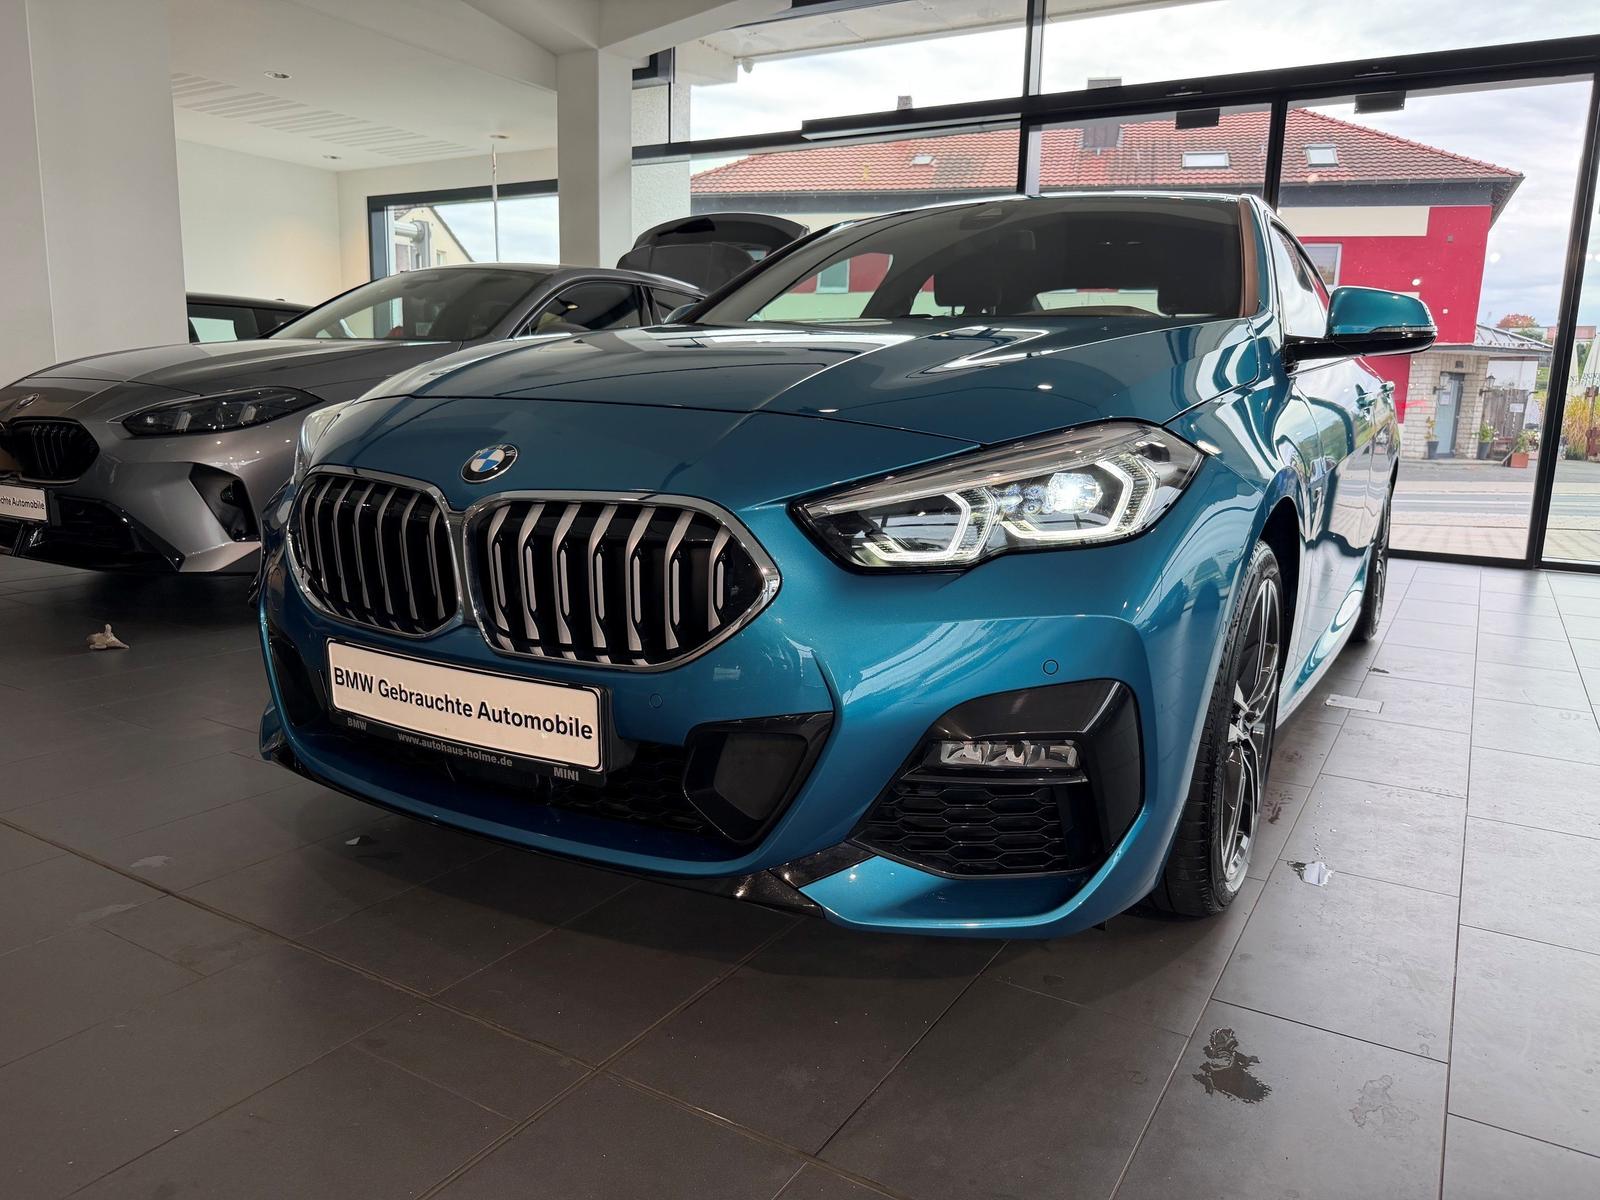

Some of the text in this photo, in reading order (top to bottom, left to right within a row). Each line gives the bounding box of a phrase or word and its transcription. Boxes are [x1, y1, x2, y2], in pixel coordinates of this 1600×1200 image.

[12, 497, 44, 510] Automobile
[334, 667, 593, 740] BMW Gebrauchte Automobile
[347, 717, 367, 731] BMW
[397, 732, 513, 767] www.autohaus-holme.de
[553, 767, 580, 782] MINI
